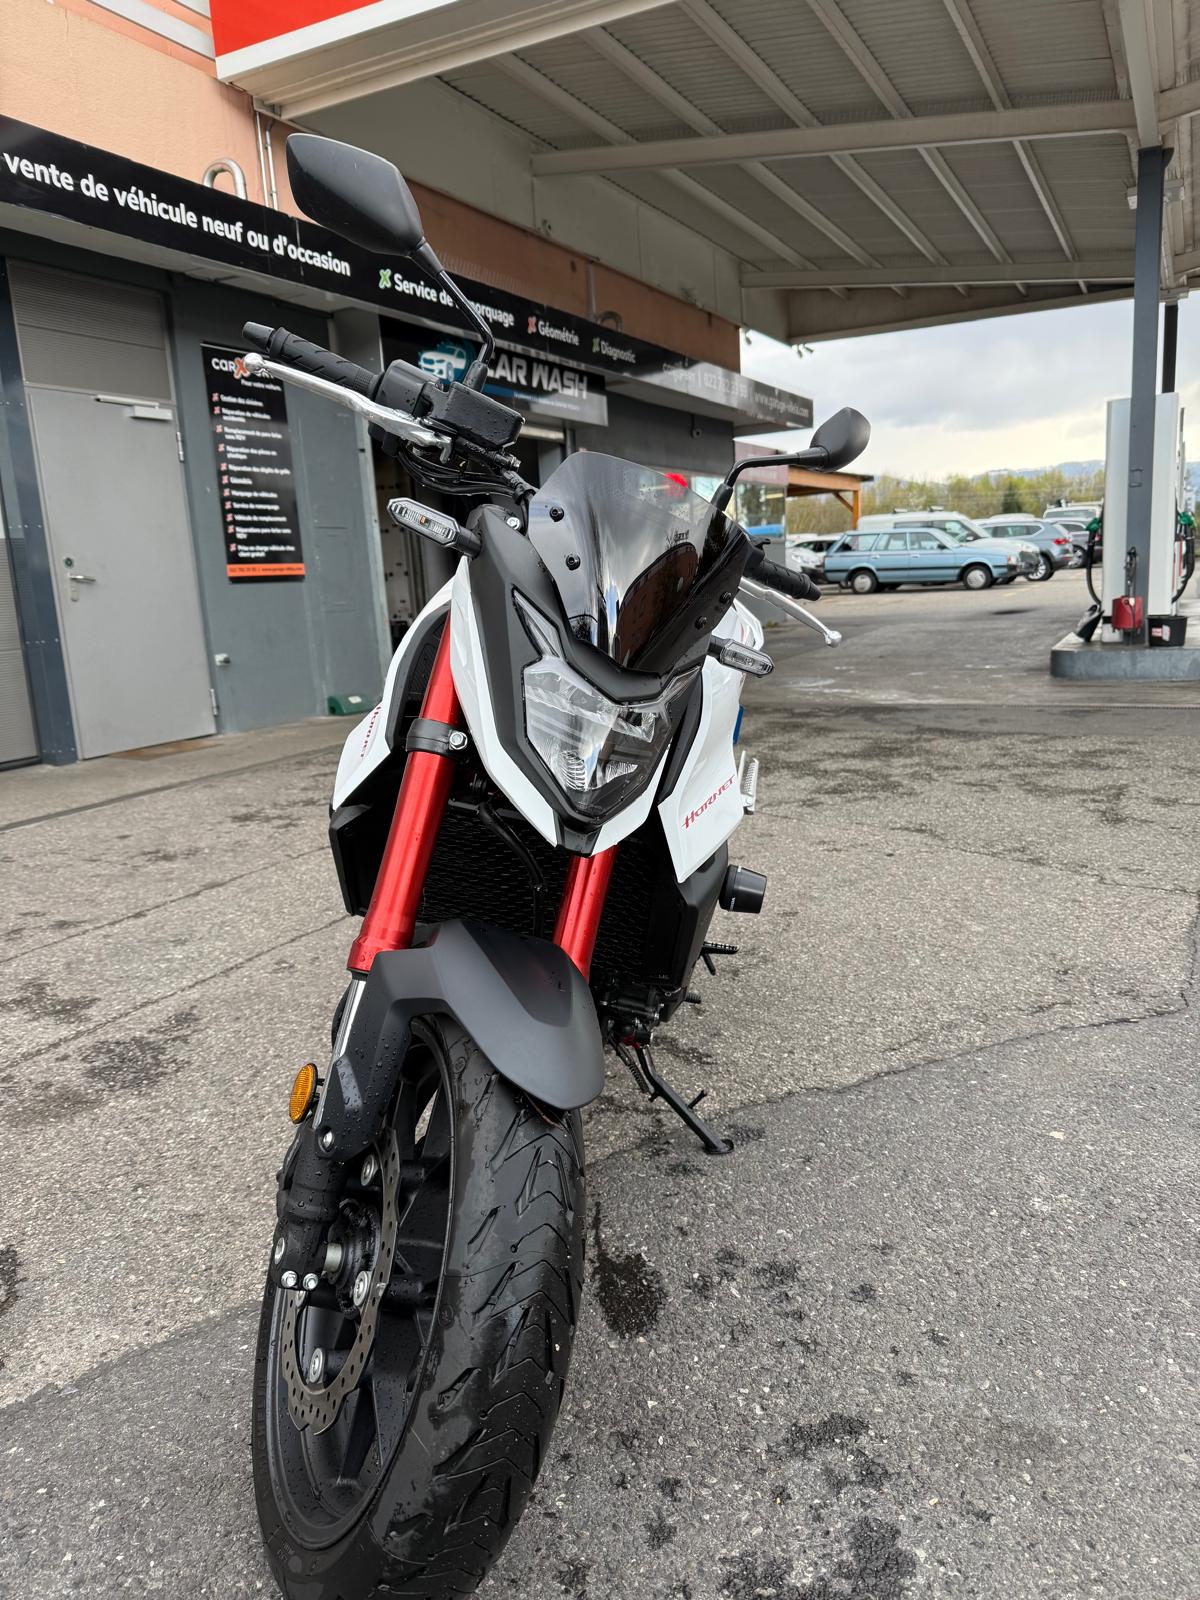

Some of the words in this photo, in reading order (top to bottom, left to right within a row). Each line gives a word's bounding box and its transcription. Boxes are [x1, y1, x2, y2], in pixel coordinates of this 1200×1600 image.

[3, 153, 75, 191] vente
[80, 173, 110, 202] de
[113, 185, 199, 229] véhicule
[201, 214, 243, 243] neuf
[246, 230, 270, 252] ou
[272, 235, 351, 277] d'occasion
[393, 272, 438, 303] Service
[439, 289, 454, 307] de
[455, 300, 515, 328] orquage
[538, 320, 580, 346] Géométrie
[600, 340, 637, 364] Diagnostic
[531, 361, 588, 400] WASH
